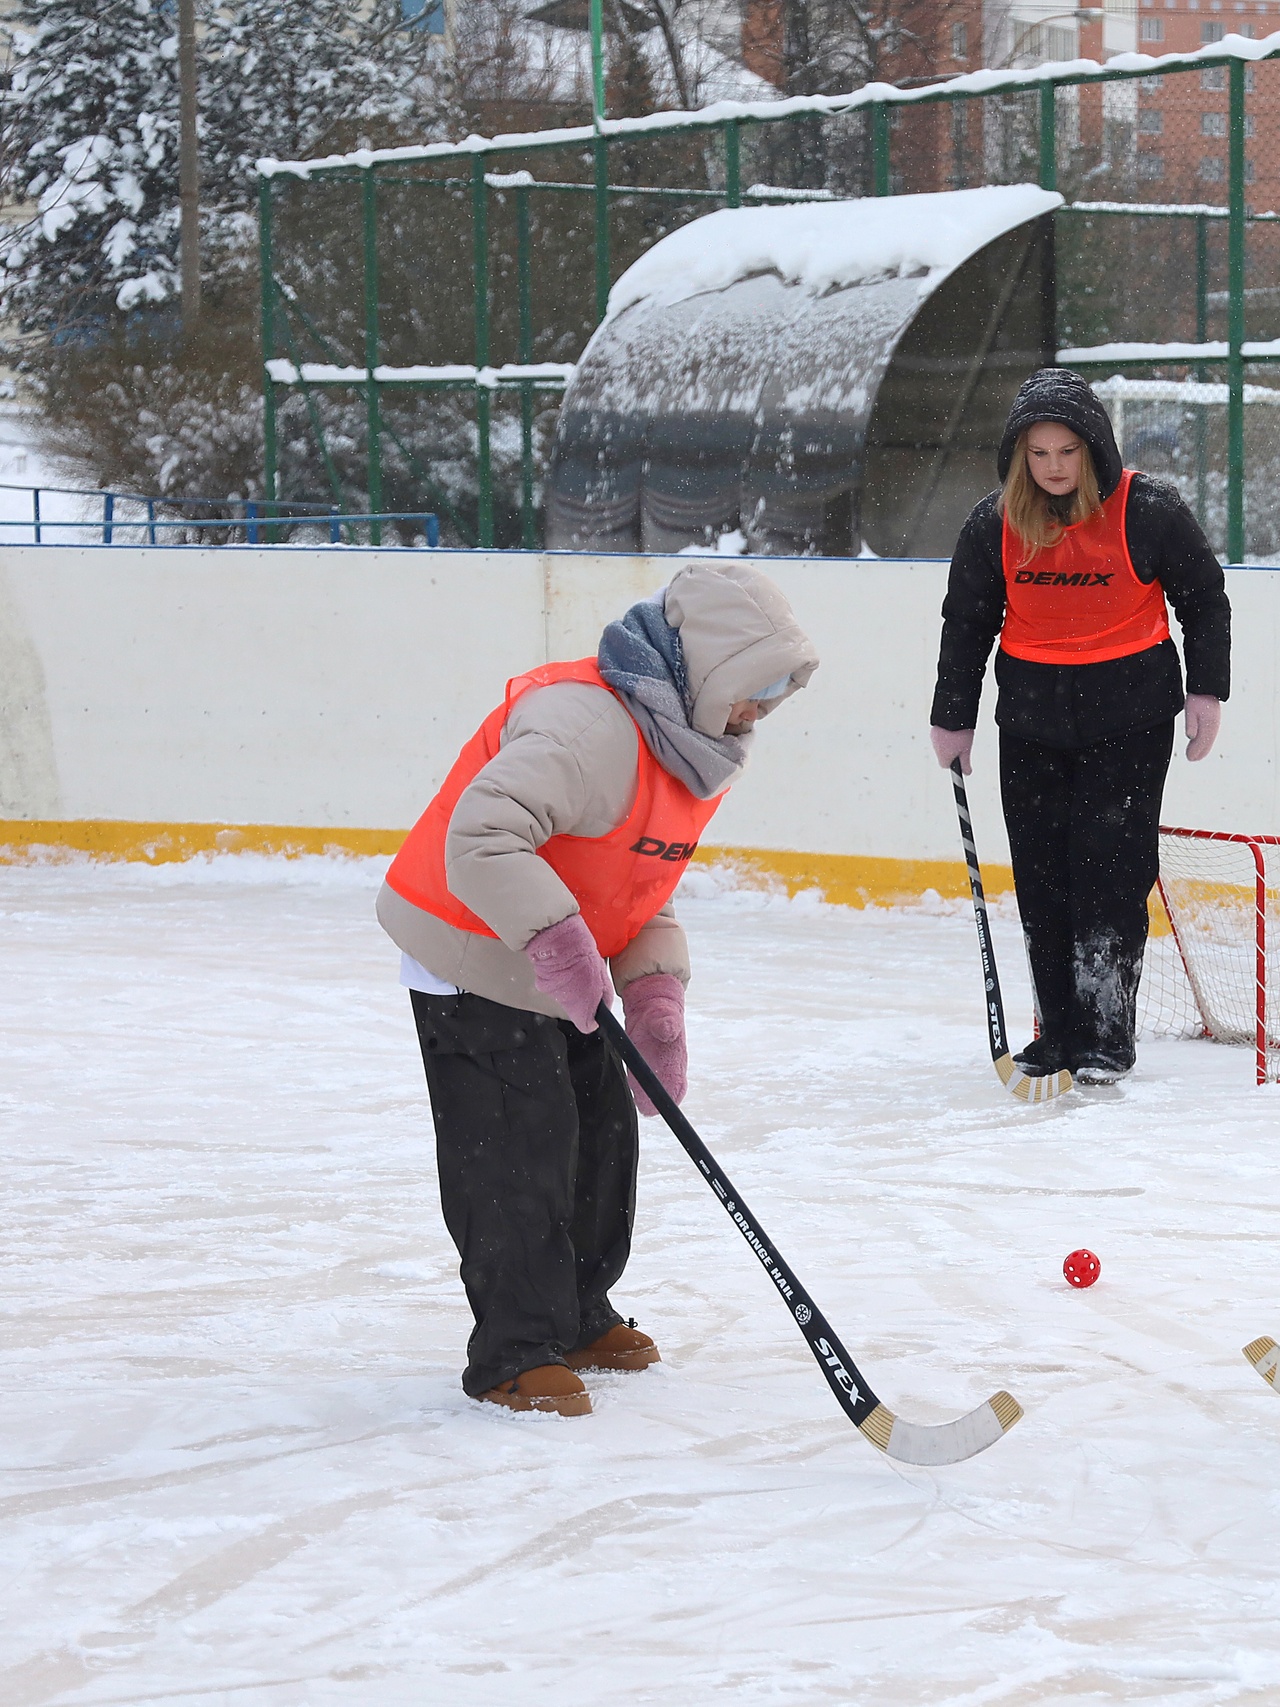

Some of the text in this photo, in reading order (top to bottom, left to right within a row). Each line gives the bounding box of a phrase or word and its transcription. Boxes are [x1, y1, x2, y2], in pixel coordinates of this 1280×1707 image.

[1014, 570, 1116, 587] DEMIX
[988, 1002, 1003, 1050] STEX
[733, 1211, 794, 1301] ORANGE HAIL
[813, 1337, 866, 1406] STEX
